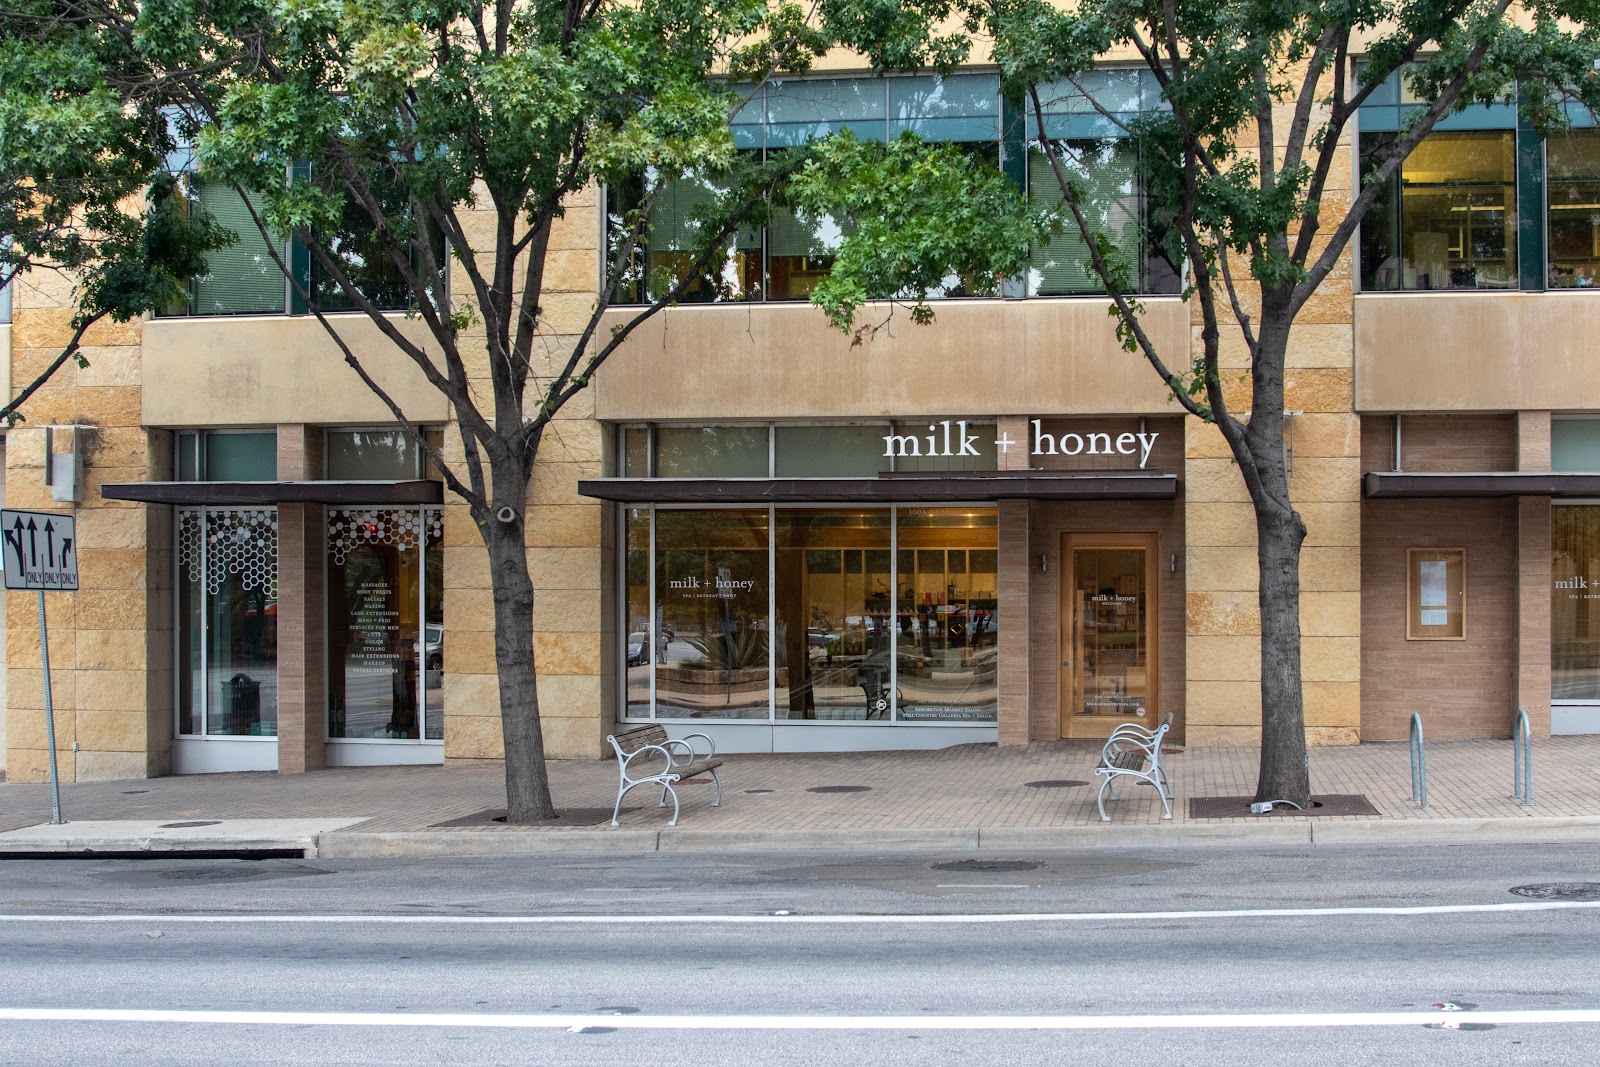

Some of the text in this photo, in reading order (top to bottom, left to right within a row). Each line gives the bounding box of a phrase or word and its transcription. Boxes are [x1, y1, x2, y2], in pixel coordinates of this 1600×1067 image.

[882, 418, 1160, 469] milk + honey
[27, 571, 77, 584] ONLY ONLY ONLY
[670, 576, 755, 592] milk + honey
[1554, 576, 1600, 589] milk +
[1091, 594, 1108, 602] milk
[1115, 594, 1137, 604] honey
